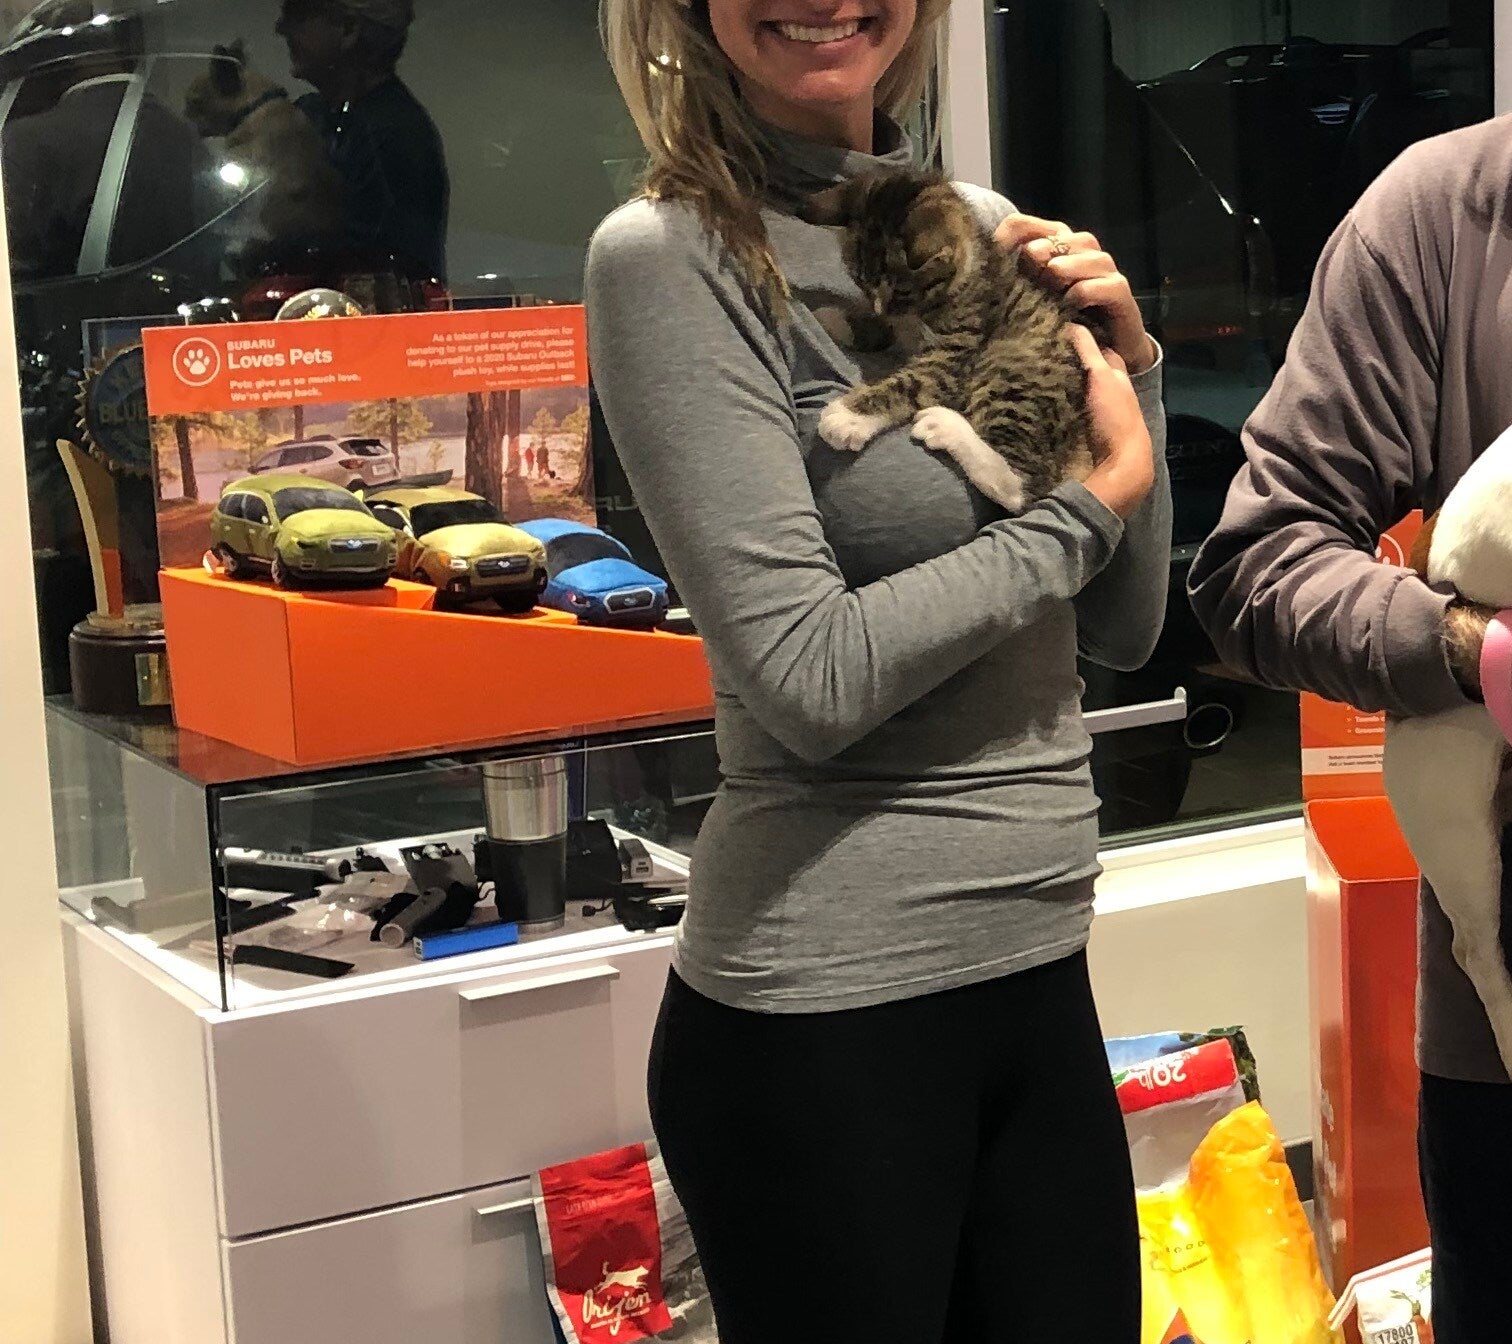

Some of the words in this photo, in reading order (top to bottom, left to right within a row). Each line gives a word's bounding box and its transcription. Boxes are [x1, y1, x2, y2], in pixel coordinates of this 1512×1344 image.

[227, 338, 276, 351] SUBARU
[227, 353, 285, 370] Loves
[290, 348, 333, 366] Pets
[1379, 1324, 1413, 1344] 17800
